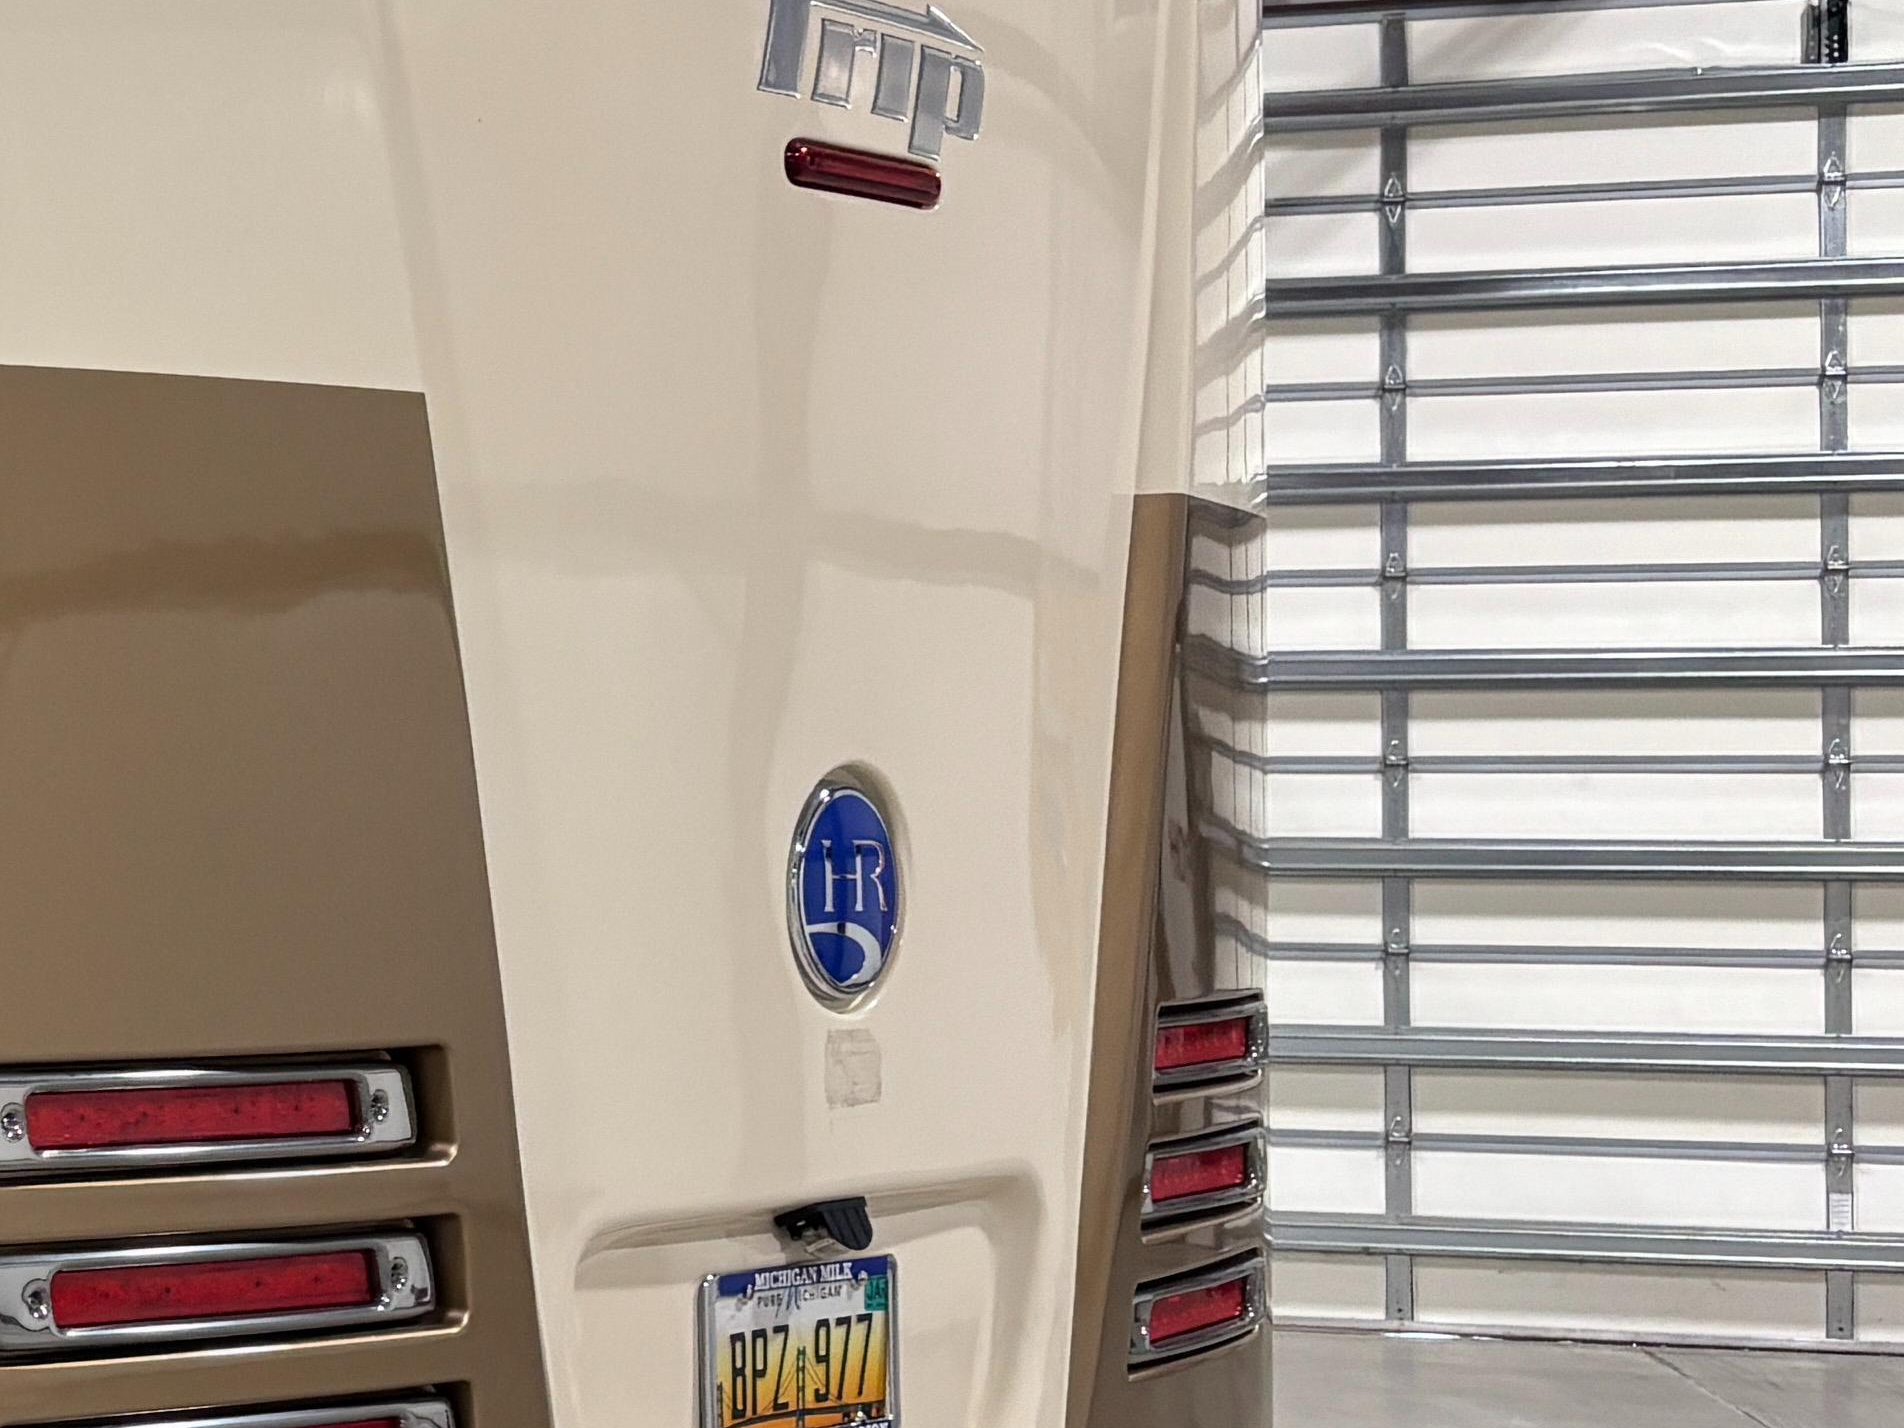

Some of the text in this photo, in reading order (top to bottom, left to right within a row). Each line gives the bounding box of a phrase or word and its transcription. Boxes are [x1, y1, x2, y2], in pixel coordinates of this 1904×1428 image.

[754, 1262, 853, 1290] MICHIGAN MILK
[729, 1312, 873, 1420] BPZ 977
